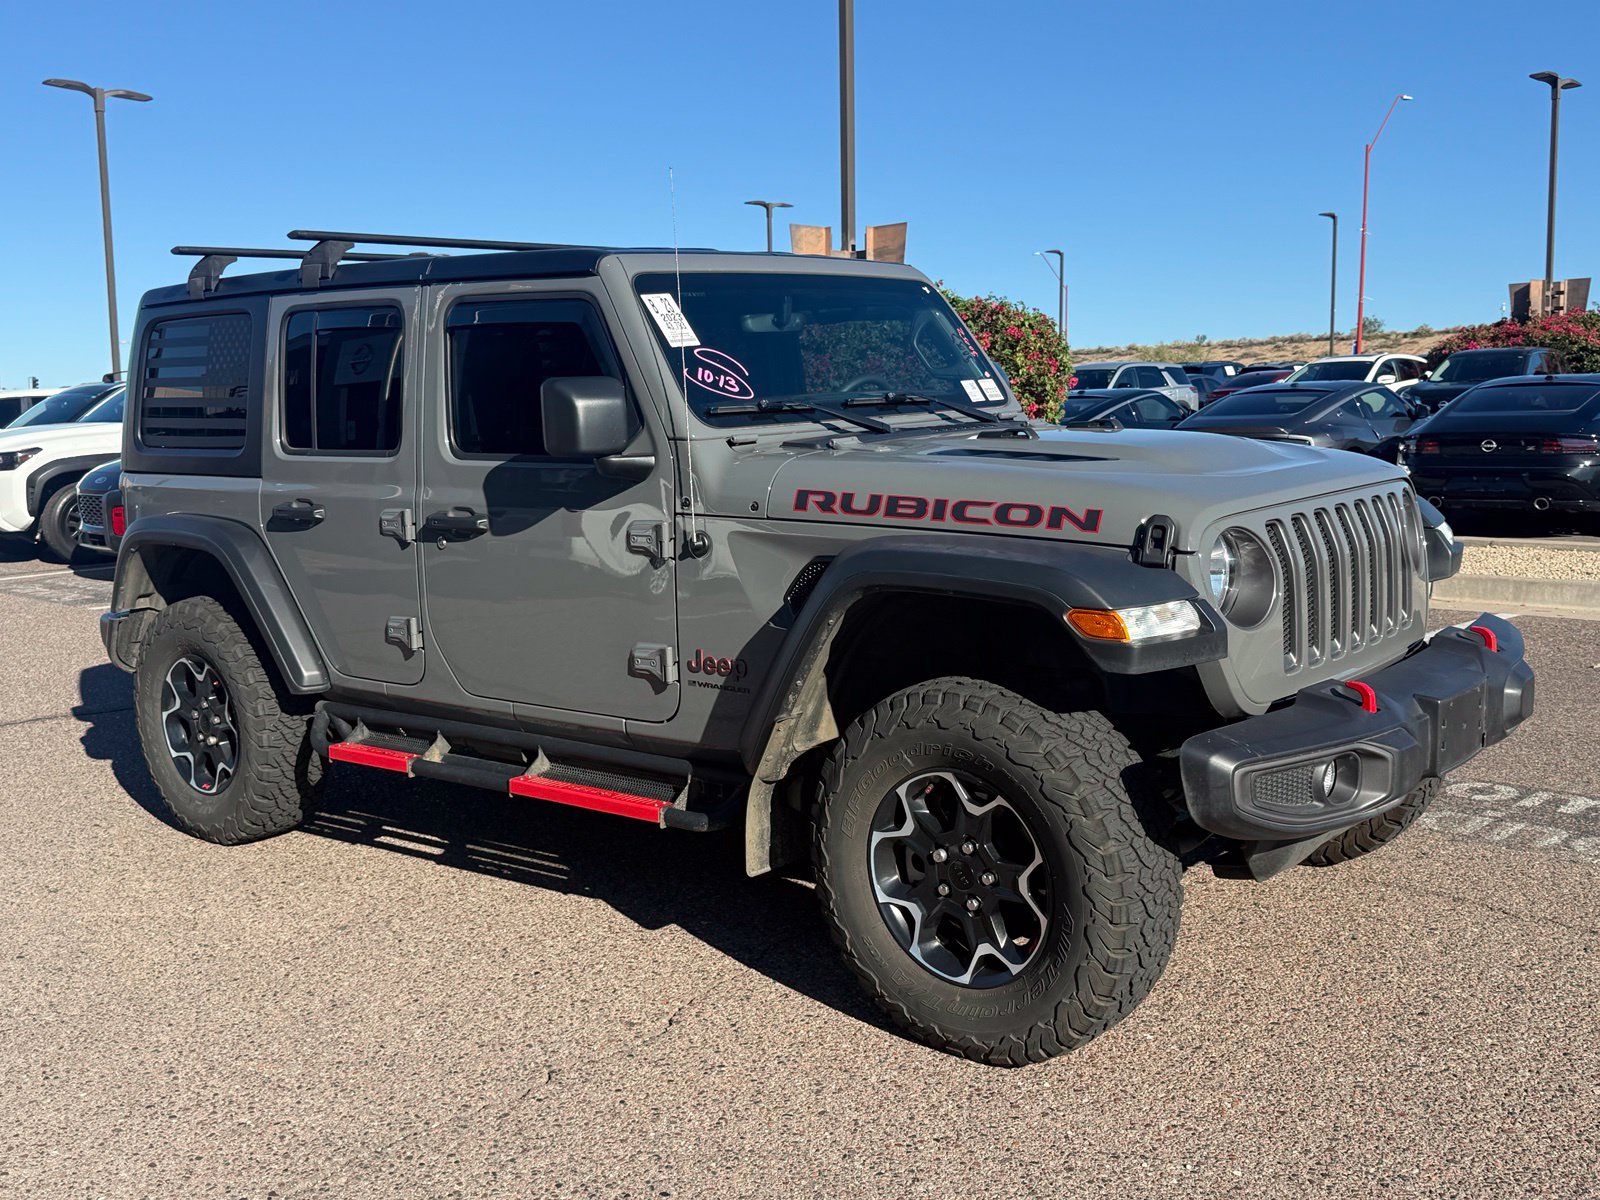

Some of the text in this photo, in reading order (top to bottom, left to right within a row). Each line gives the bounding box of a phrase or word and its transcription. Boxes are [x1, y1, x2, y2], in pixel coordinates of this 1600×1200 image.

[660, 313, 683, 322] 2023
[792, 488, 1104, 533] RUBICON
[686, 647, 748, 682] Jeep
[697, 681, 751, 694] WRANGLER
[840, 741, 995, 840] BFGoodrich
